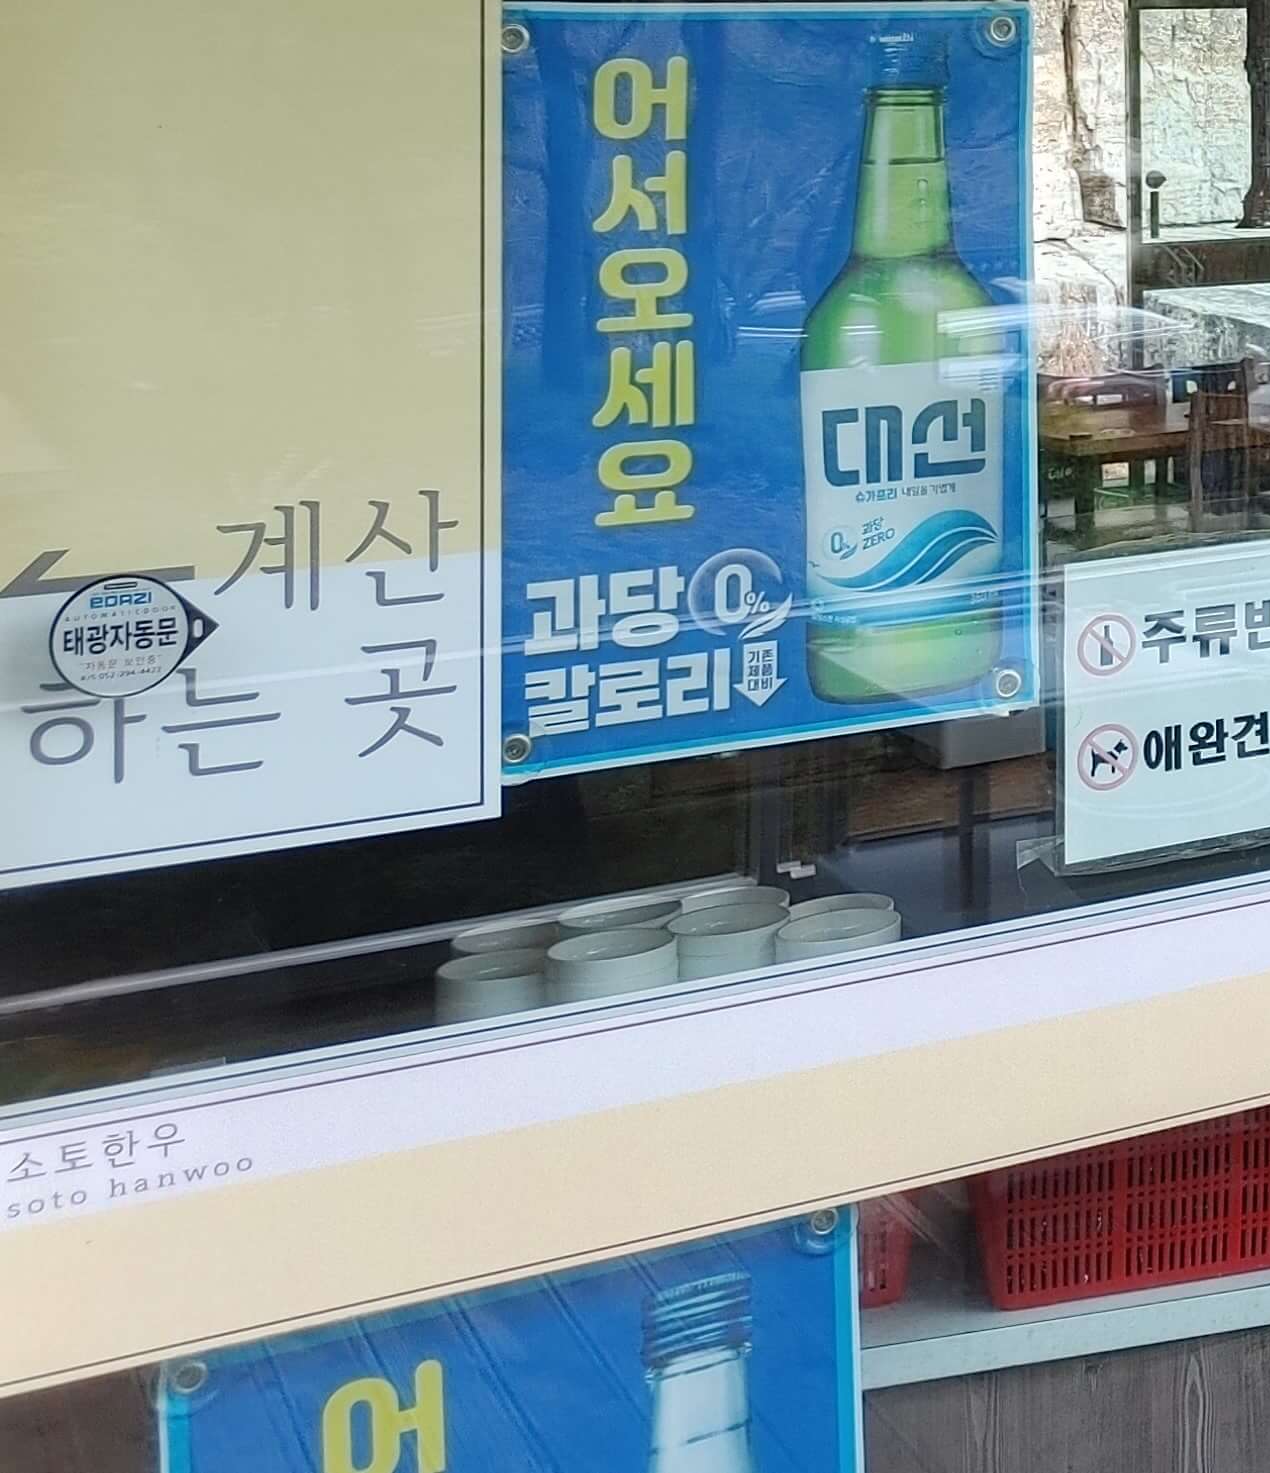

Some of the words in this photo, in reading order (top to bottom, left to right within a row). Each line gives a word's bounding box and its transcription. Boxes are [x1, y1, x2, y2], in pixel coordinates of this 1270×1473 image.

[592, 56, 696, 528] 어서오세요
[822, 397, 987, 488] 대선
[214, 490, 459, 611] 계산
[862, 528, 896, 550] ZERO
[64, 617, 179, 656] 태광자동문
[524, 566, 686, 656] 과당
[344, 639, 457, 758] 곳
[524, 647, 731, 738] 칼로리
[7, 1123, 186, 1182] 소토한우
[7, 1189, 88, 1219] soto
[109, 1157, 254, 1198] hanwoo
